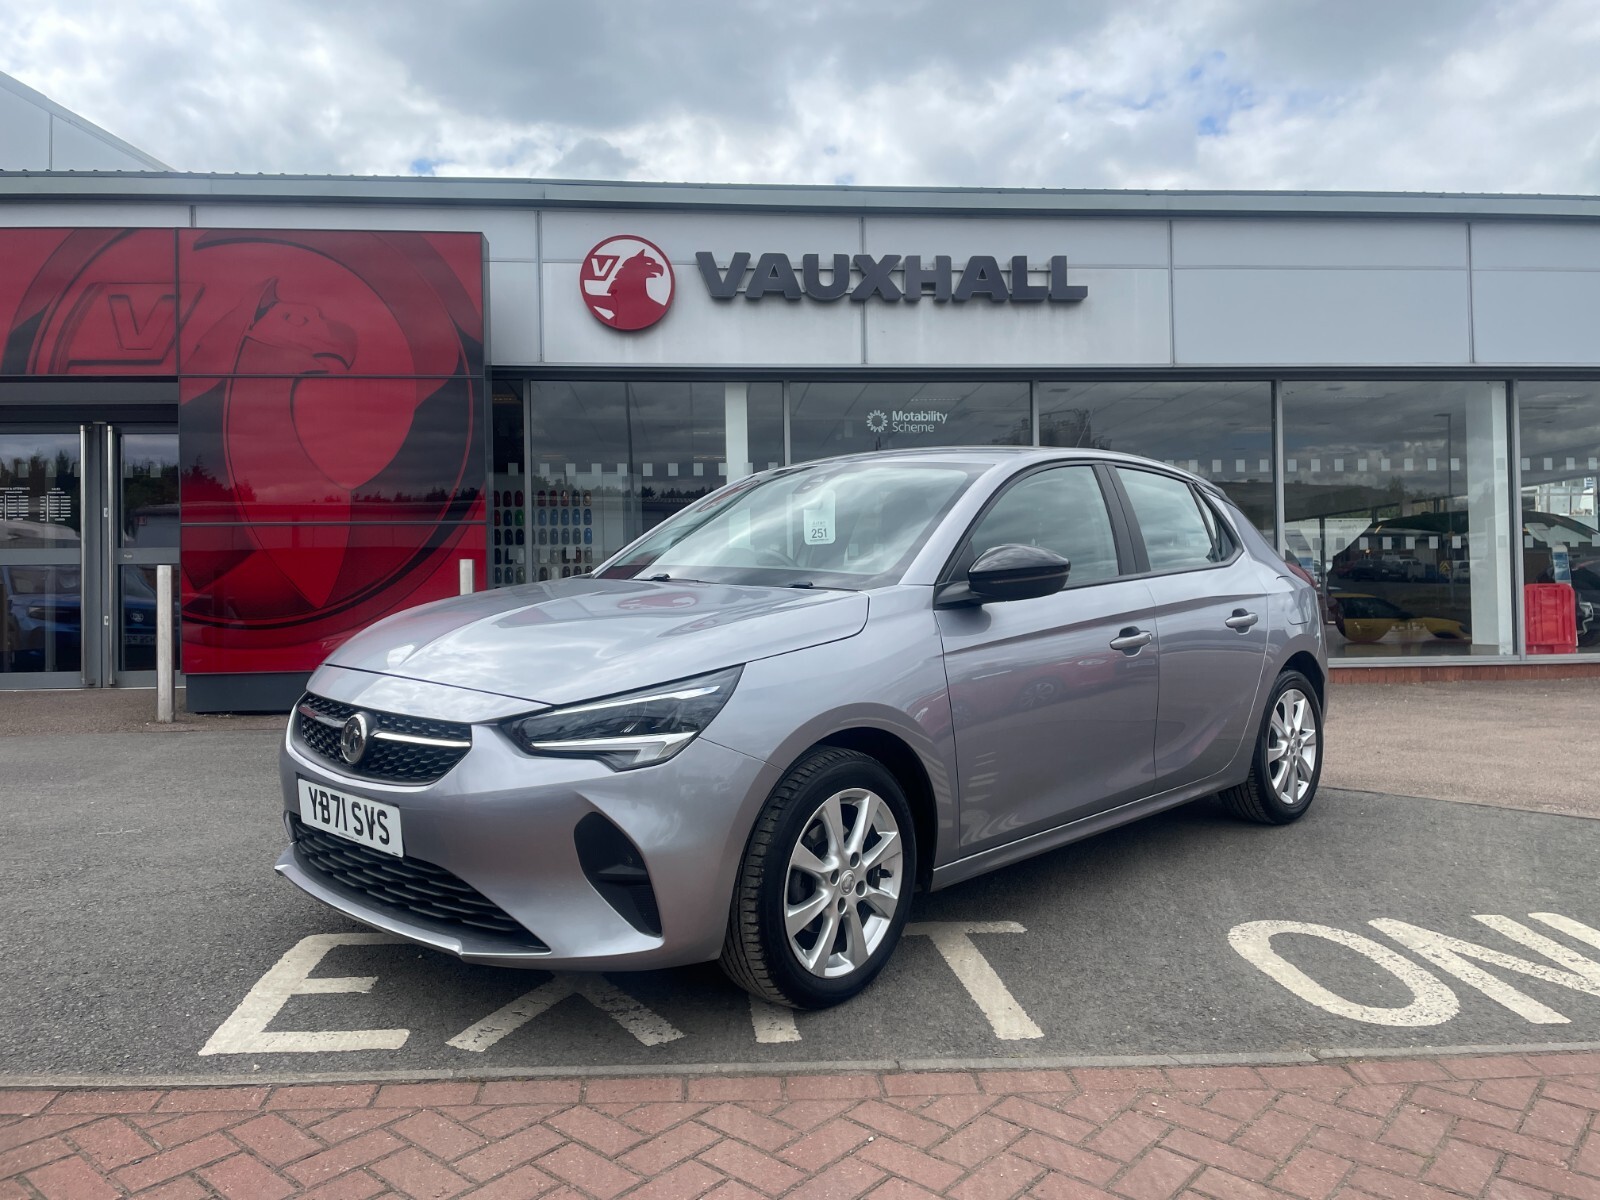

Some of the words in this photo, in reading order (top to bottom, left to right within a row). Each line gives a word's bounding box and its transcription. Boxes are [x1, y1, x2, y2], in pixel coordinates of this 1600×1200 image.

[695, 251, 1089, 303] VAUXHALL
[892, 410, 948, 424] Motability
[892, 421, 935, 433] Scheme
[811, 527, 828, 539] 251
[308, 786, 348, 832] YB71
[351, 801, 390, 846] SVS
